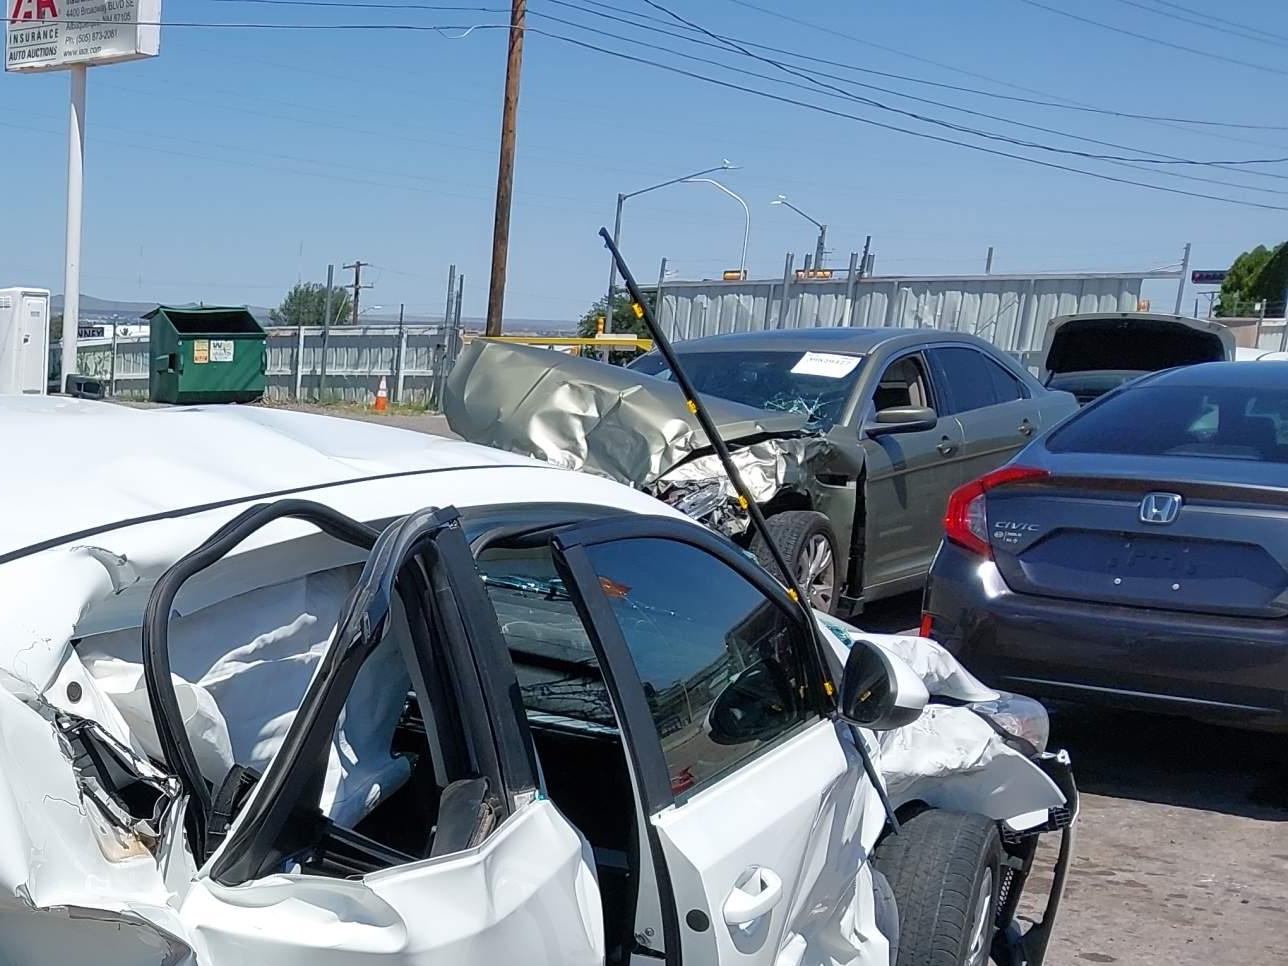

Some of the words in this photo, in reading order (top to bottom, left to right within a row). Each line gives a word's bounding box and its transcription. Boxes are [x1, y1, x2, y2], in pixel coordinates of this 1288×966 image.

[108, 0, 125, 10] BLVD
[9, 28, 58, 45] INSURANCE
[8, 50, 26, 61] AUTO
[27, 46, 57, 58] AUCTIONS
[995, 521, 1040, 531] CIVIC
